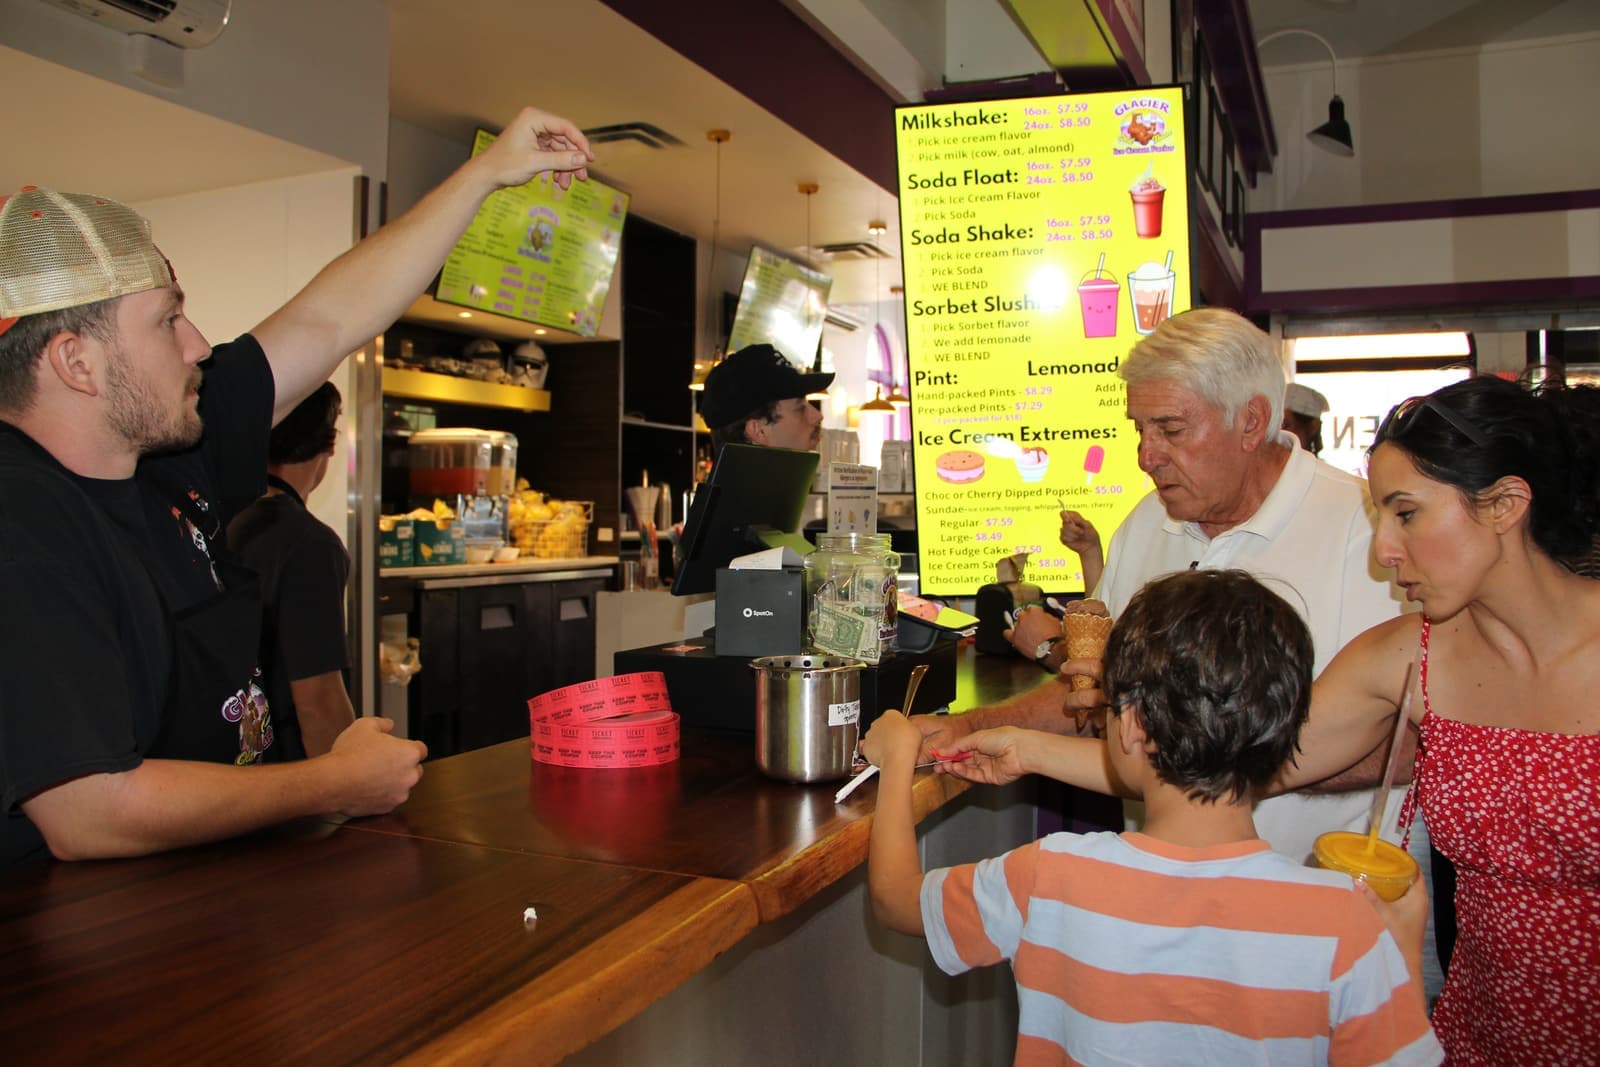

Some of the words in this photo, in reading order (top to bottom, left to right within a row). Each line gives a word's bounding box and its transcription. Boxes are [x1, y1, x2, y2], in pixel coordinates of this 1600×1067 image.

[1024, 106, 1050, 116] 16oz.
[1057, 103, 1088, 114] $7.59
[1115, 98, 1169, 116] GLACIER
[902, 108, 1008, 131] Milkshake:
[1024, 120, 1053, 130] 24oz.
[1059, 117, 1091, 128] $8.50
[918, 137, 940, 147] Pick
[943, 136, 959, 145] ice
[962, 134, 996, 144] cream
[999, 130, 1032, 141] flavor
[918, 152, 940, 162] Pick
[944, 150, 967, 161] milk
[970, 147, 998, 159] (cow,
[1003, 147, 1025, 156] oat,
[1028, 142, 1075, 155] almond)
[1026, 161, 1053, 171] 16oz.
[1060, 158, 1091, 169] $7.59
[908, 171, 957, 190] Soda
[963, 169, 1019, 187] Float:
[1026, 175, 1056, 185] 24oz.
[1062, 172, 1094, 183] $8.50
[923, 197, 945, 206] Pick
[949, 195, 965, 205] Ice
[968, 194, 1003, 203] Cream
[1007, 190, 1041, 201] Flavor
[924, 212, 946, 221] Pick
[950, 210, 976, 220] Soda
[1046, 218, 1074, 228] 16oz.
[1080, 215, 1110, 226] $7.59
[911, 228, 961, 246] Soda
[967, 223, 1033, 243] Shake:
[1046, 232, 1075, 242] 24oz.
[1081, 229, 1113, 240] $8.50
[931, 252, 952, 261] Pick
[956, 251, 972, 260] ice
[975, 249, 1009, 259] cream
[1012, 246, 1044, 256] flavor
[932, 267, 954, 276] Pick
[957, 265, 983, 276] Soda
[932, 283, 949, 292] WE
[952, 280, 988, 291] BLEND
[913, 297, 978, 316] Sorbet
[933, 323, 954, 332] Pick
[958, 321, 993, 331] Sorbet
[997, 319, 1029, 329] flavor
[934, 339, 951, 347] We
[954, 337, 974, 346] add
[977, 334, 1031, 345] lemonade
[935, 354, 951, 362] WE
[954, 351, 990, 361] BLEND
[1028, 356, 1119, 376] Lemonad
[915, 370, 958, 386] Pint:
[917, 390, 986, 401] Hand-packed
[989, 388, 1016, 397] Pints
[1025, 386, 1052, 396] $8.29
[1095, 384, 1116, 393] Add
[918, 405, 976, 417] Pre-packed
[979, 403, 1006, 413] Pints
[1015, 401, 1042, 411] $7.29
[1099, 398, 1120, 407] Add
[919, 431, 943, 445] Ice
[949, 428, 1013, 446] Cream
[1020, 424, 1117, 442] Extremes:
[925, 492, 950, 500] Choc
[967, 490, 1002, 501] Cherry
[1005, 487, 1042, 499] Dipped
[1045, 486, 1092, 498] Popsicle-
[1095, 485, 1122, 495] $5.00
[1090, 501, 1114, 511] cherry
[985, 517, 1013, 528] $7.59
[941, 533, 973, 544] Large-
[928, 547, 947, 557] Hot
[949, 545, 980, 557] Fudge
[983, 546, 1012, 556] Cake-
[1014, 545, 1042, 554] $7.50
[928, 562, 943, 570] Ice
[946, 561, 980, 570] Cream
[1038, 559, 1066, 568] $8.00
[929, 575, 980, 584] Chocolate
[1029, 573, 1072, 583] Banana-
